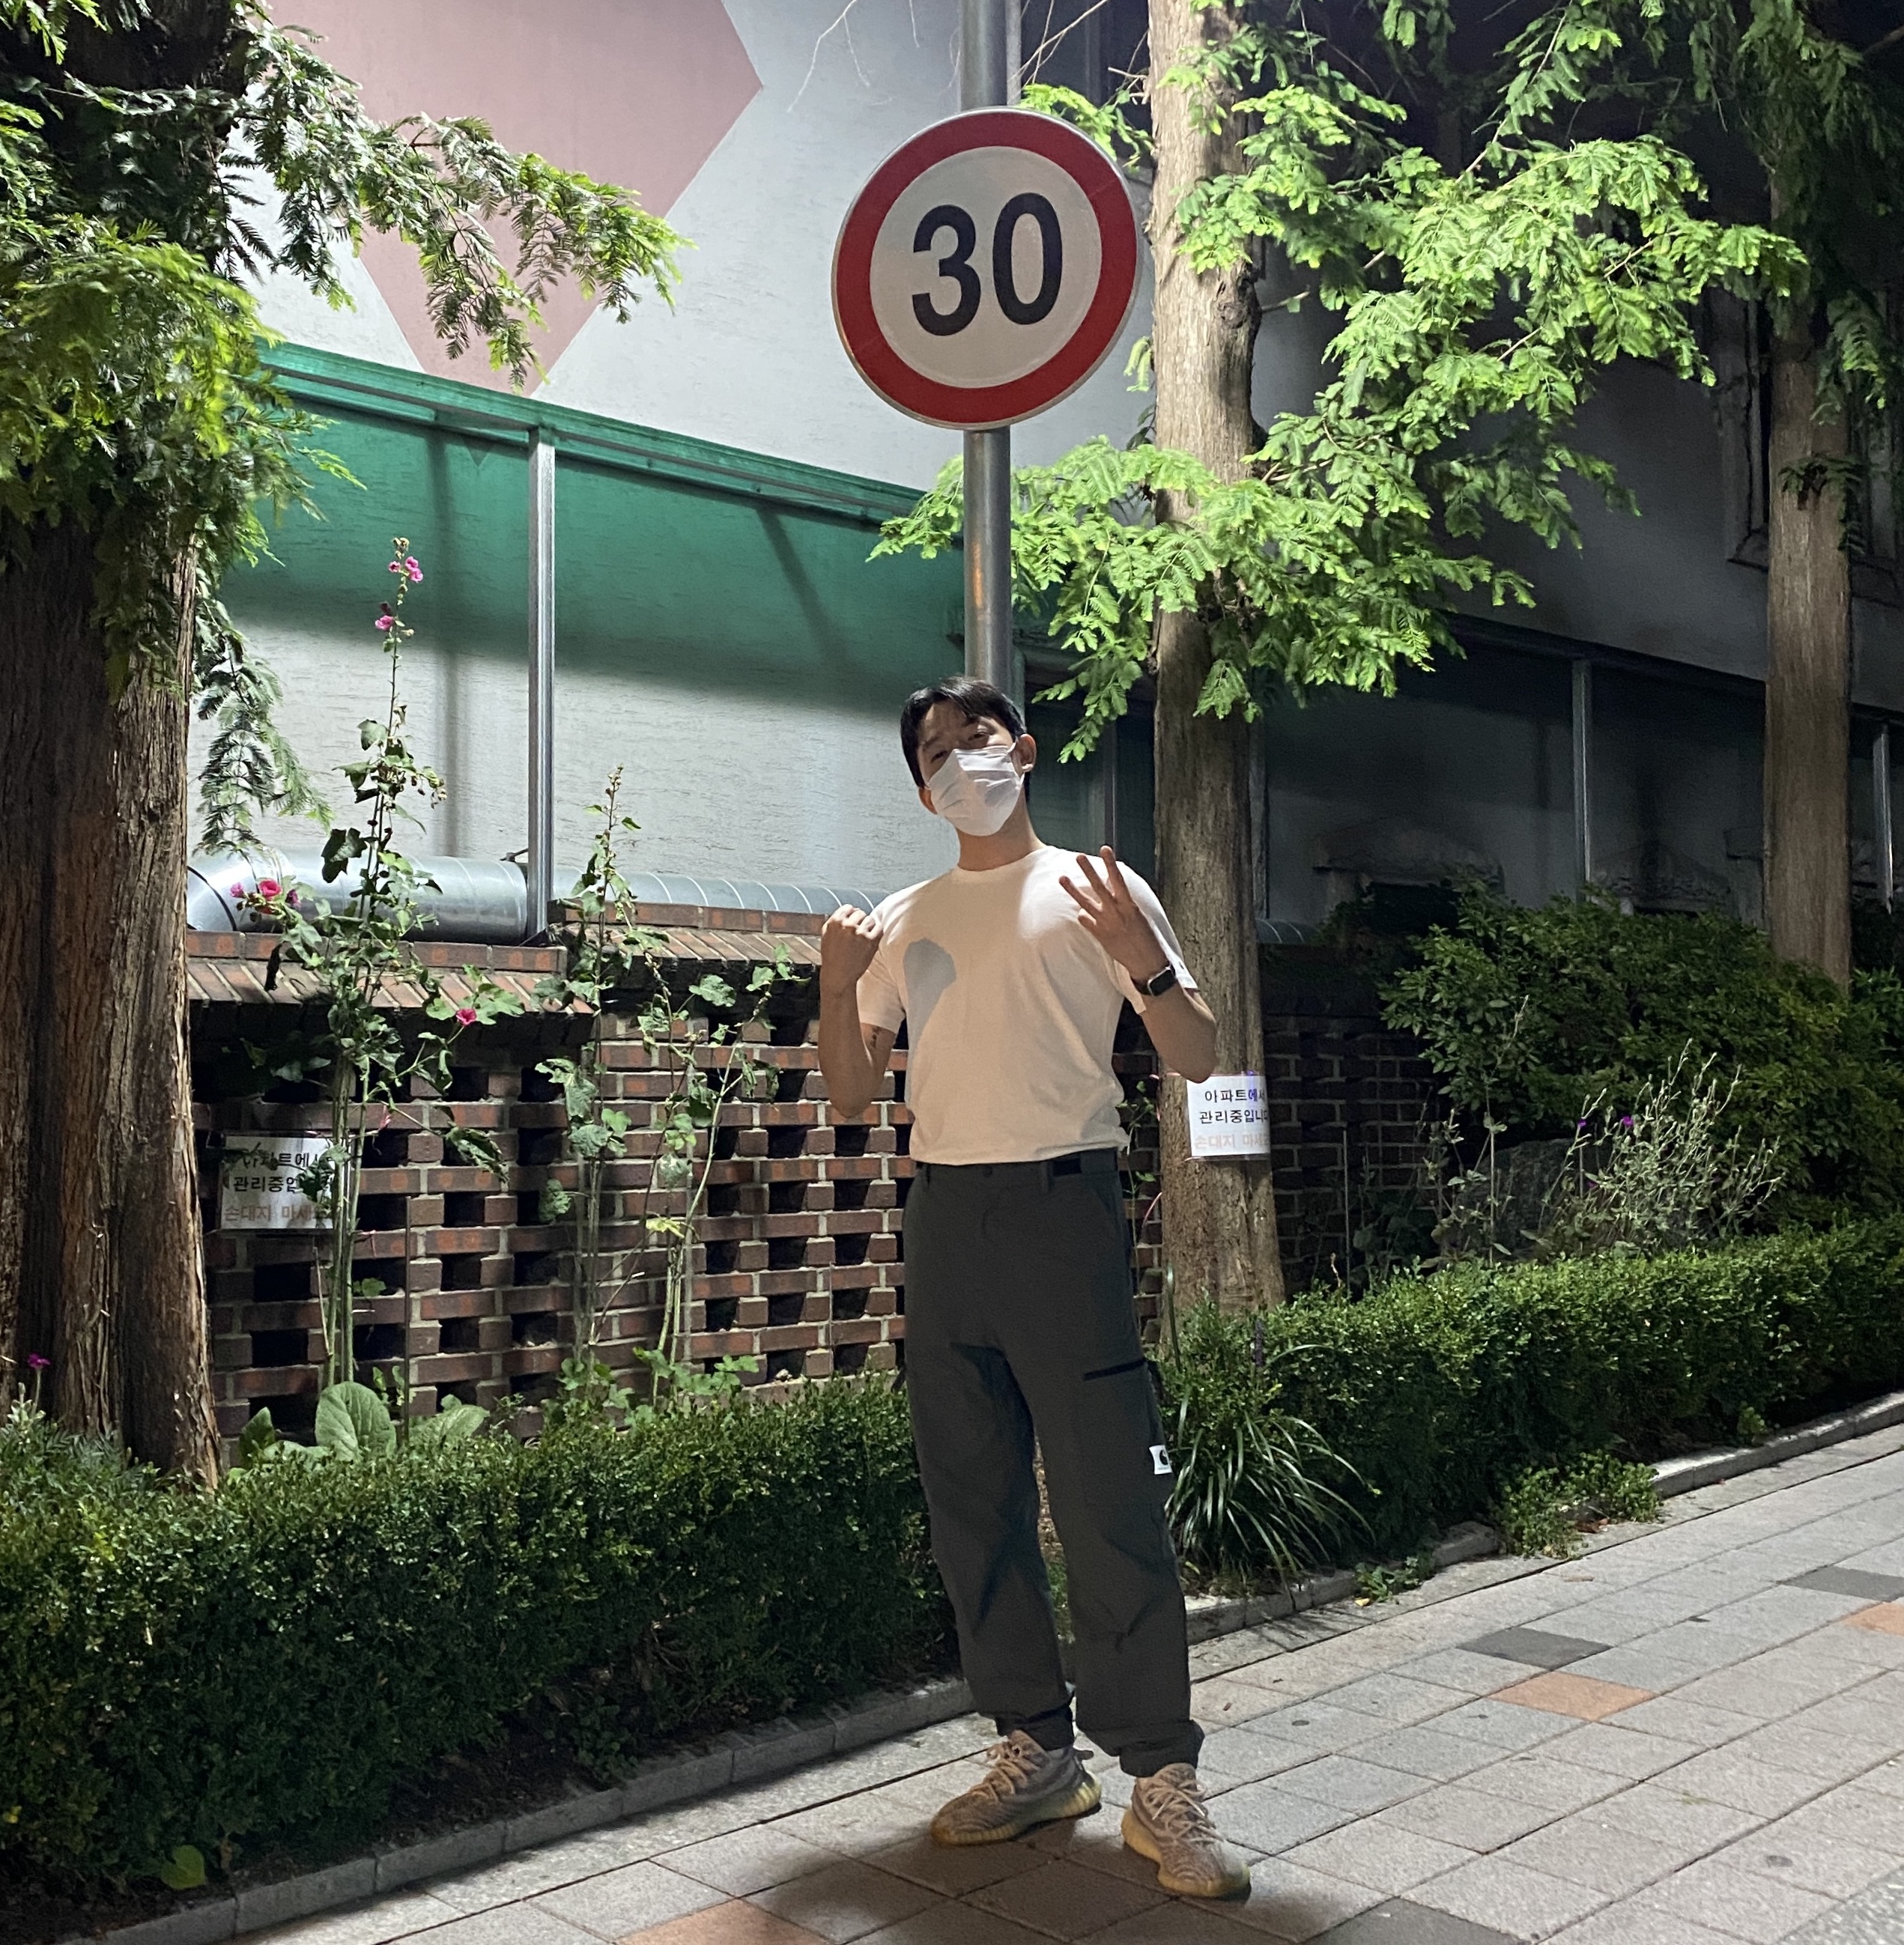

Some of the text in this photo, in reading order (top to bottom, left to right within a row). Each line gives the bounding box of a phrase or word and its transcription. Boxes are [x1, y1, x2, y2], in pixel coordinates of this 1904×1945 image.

[912, 192, 1063, 336] 30
[1204, 1088, 1266, 1103] 아파트에서
[1194, 1133, 1235, 1150] 손대지
[234, 1176, 315, 1192] 관리중입
[225, 1204, 315, 1222] 손대지 마세
